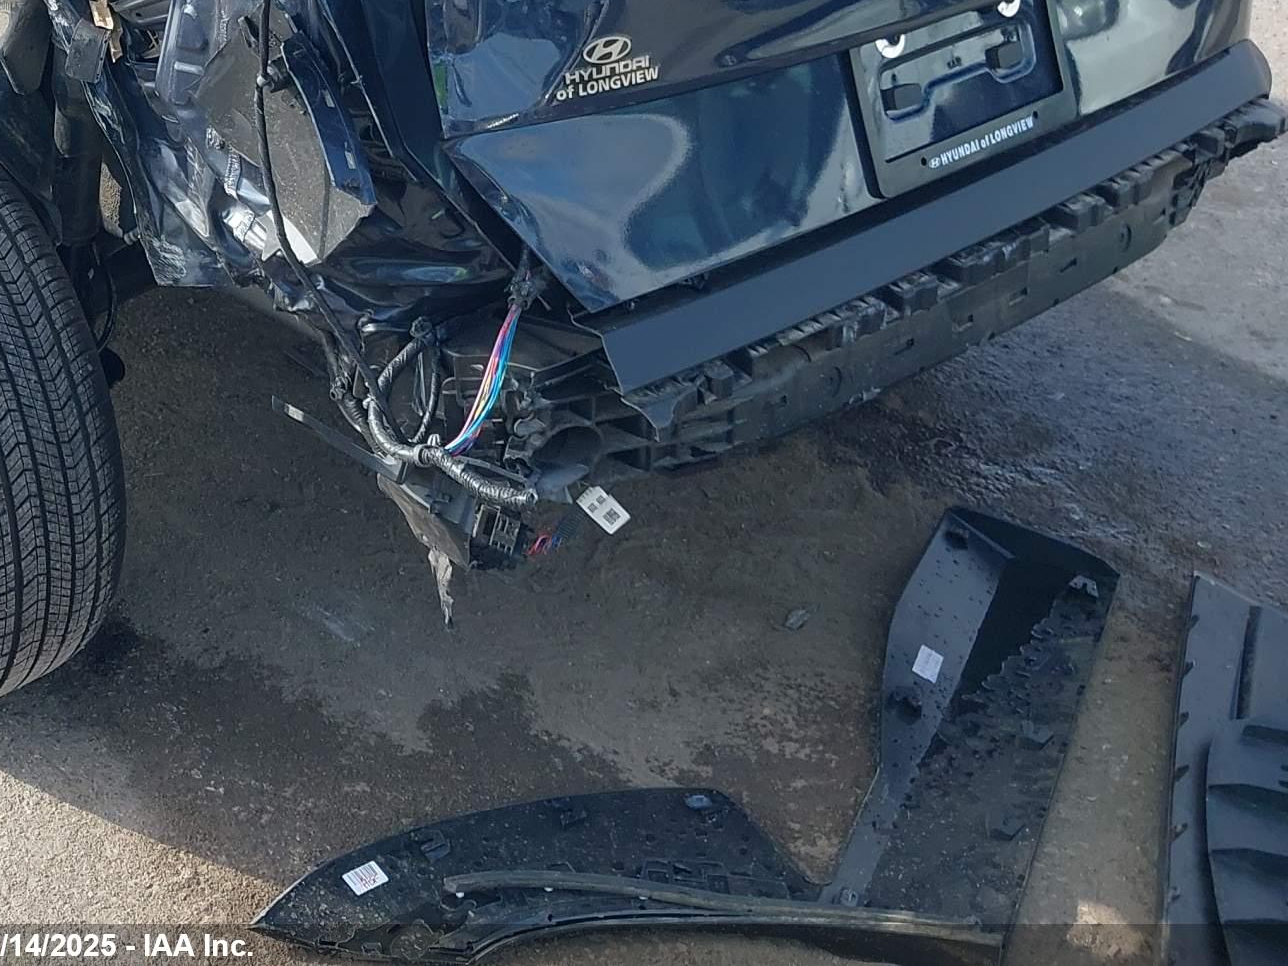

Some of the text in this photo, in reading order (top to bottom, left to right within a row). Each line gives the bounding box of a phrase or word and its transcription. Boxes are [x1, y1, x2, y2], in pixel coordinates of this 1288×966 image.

[564, 55, 650, 84] HYUNDAI
[578, 66, 659, 96] LONGVIEW
[940, 116, 1034, 165] HYUNDAI of LONGVIEW
